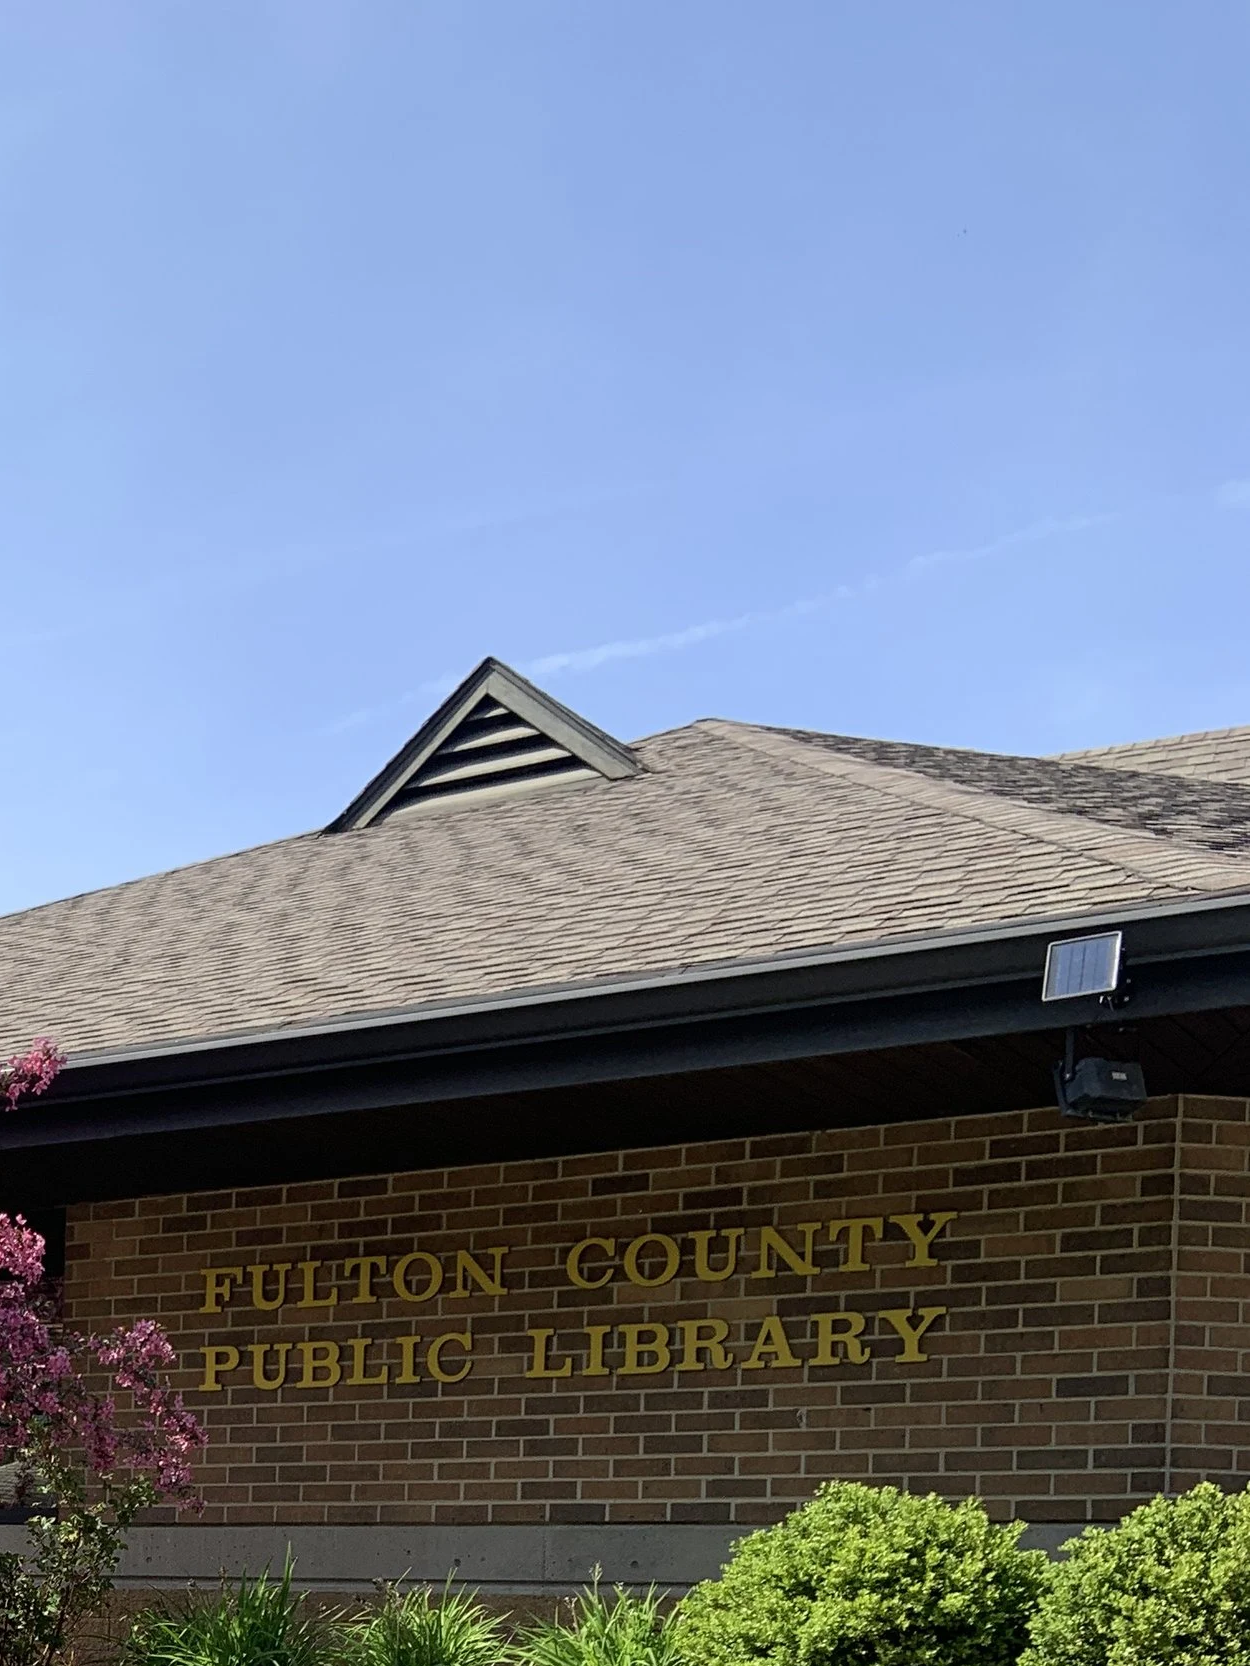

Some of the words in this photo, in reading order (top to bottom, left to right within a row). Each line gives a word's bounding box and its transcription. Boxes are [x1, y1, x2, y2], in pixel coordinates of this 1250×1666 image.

[198, 1246, 509, 1314] FULTON
[565, 1211, 958, 1289] COUNTY
[198, 1332, 474, 1391] PUBLIC
[525, 1306, 947, 1378] LIBRARY
